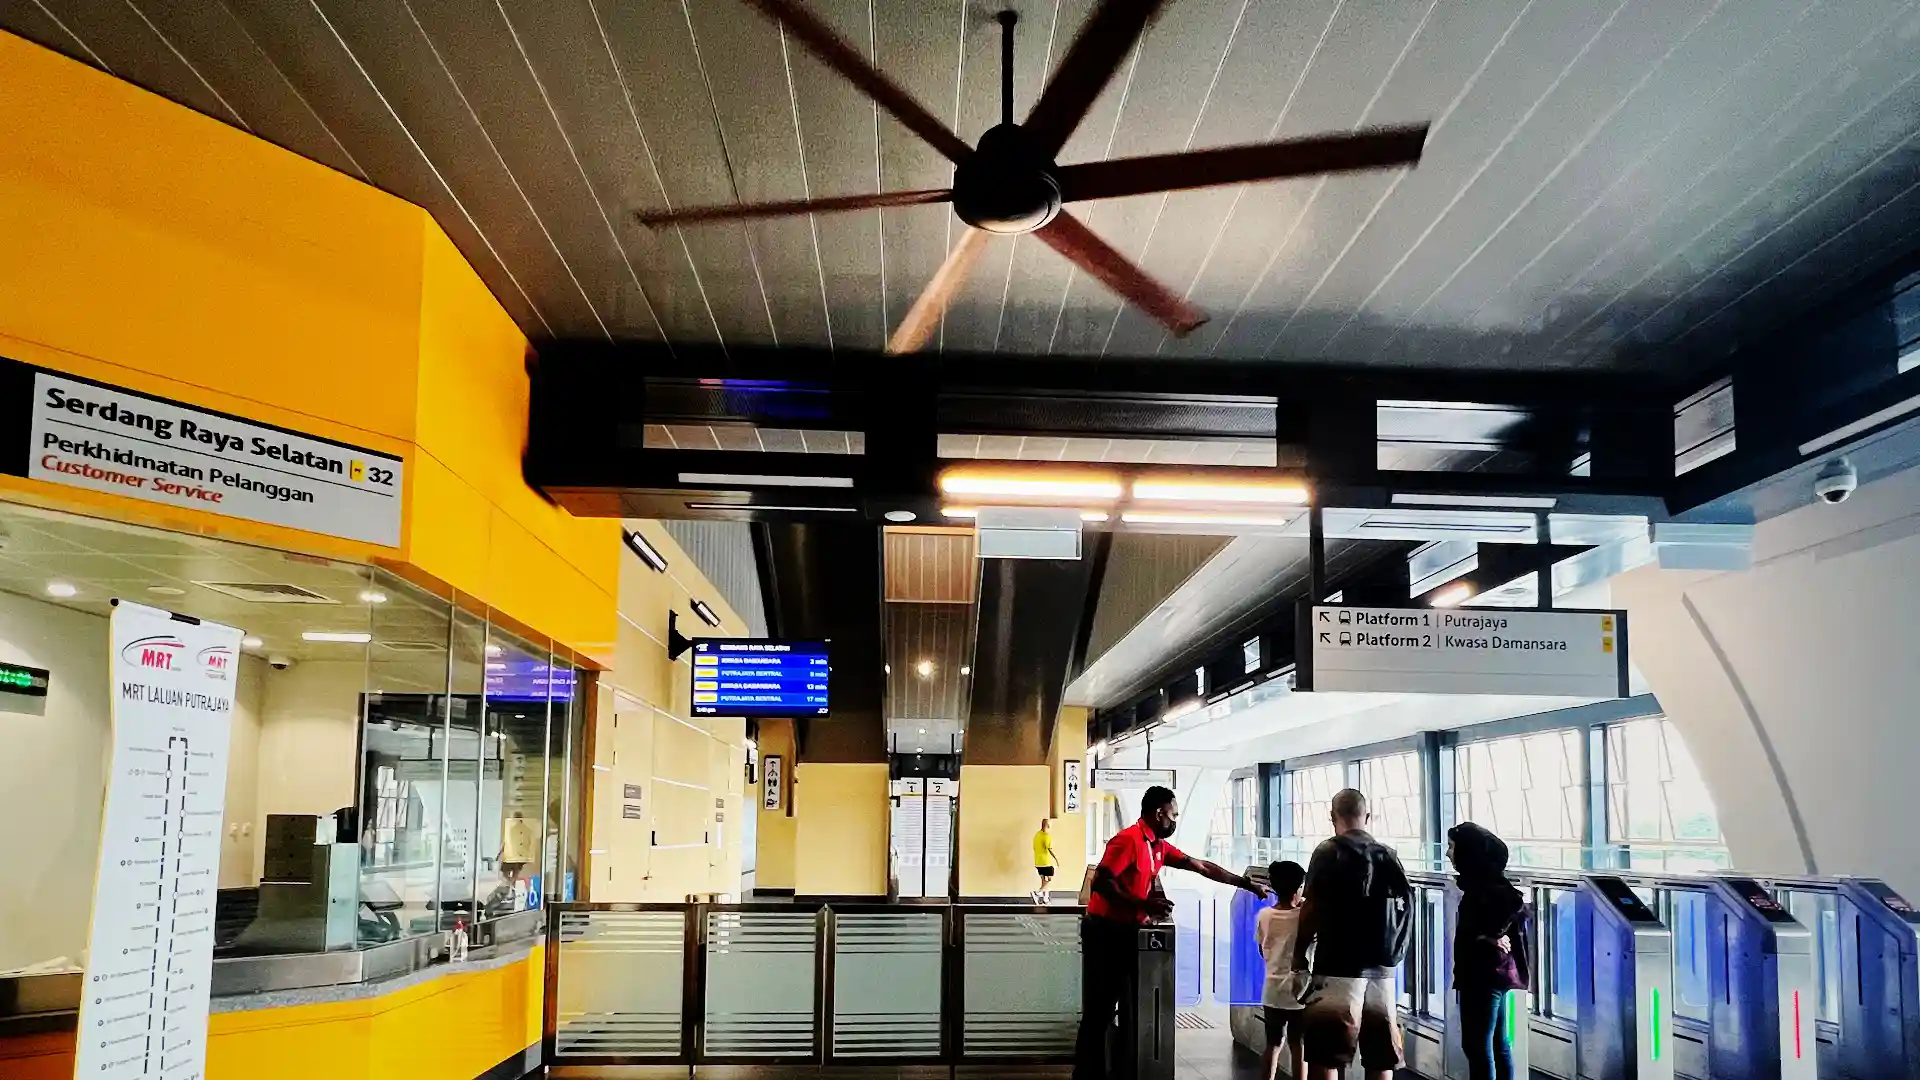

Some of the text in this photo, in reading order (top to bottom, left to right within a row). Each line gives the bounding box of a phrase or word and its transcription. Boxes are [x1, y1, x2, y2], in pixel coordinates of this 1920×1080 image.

[45, 387, 394, 486] Serdang Raya Selatan 32
[43, 432, 314, 503] Perkhidmatan Pelanggan
[41, 454, 223, 503] Customer Service
[1356, 612, 1508, 632] Platform 1 Putrajaya
[1356, 633, 1567, 651] Platform 2 Kwasa Damansara
[141, 648, 173, 670] MRT
[208, 655, 228, 669] MRT
[122, 682, 229, 712] MRT LALUAN PUTRAJAYA
[909, 785, 914, 793] 1
[935, 785, 941, 793] 2
